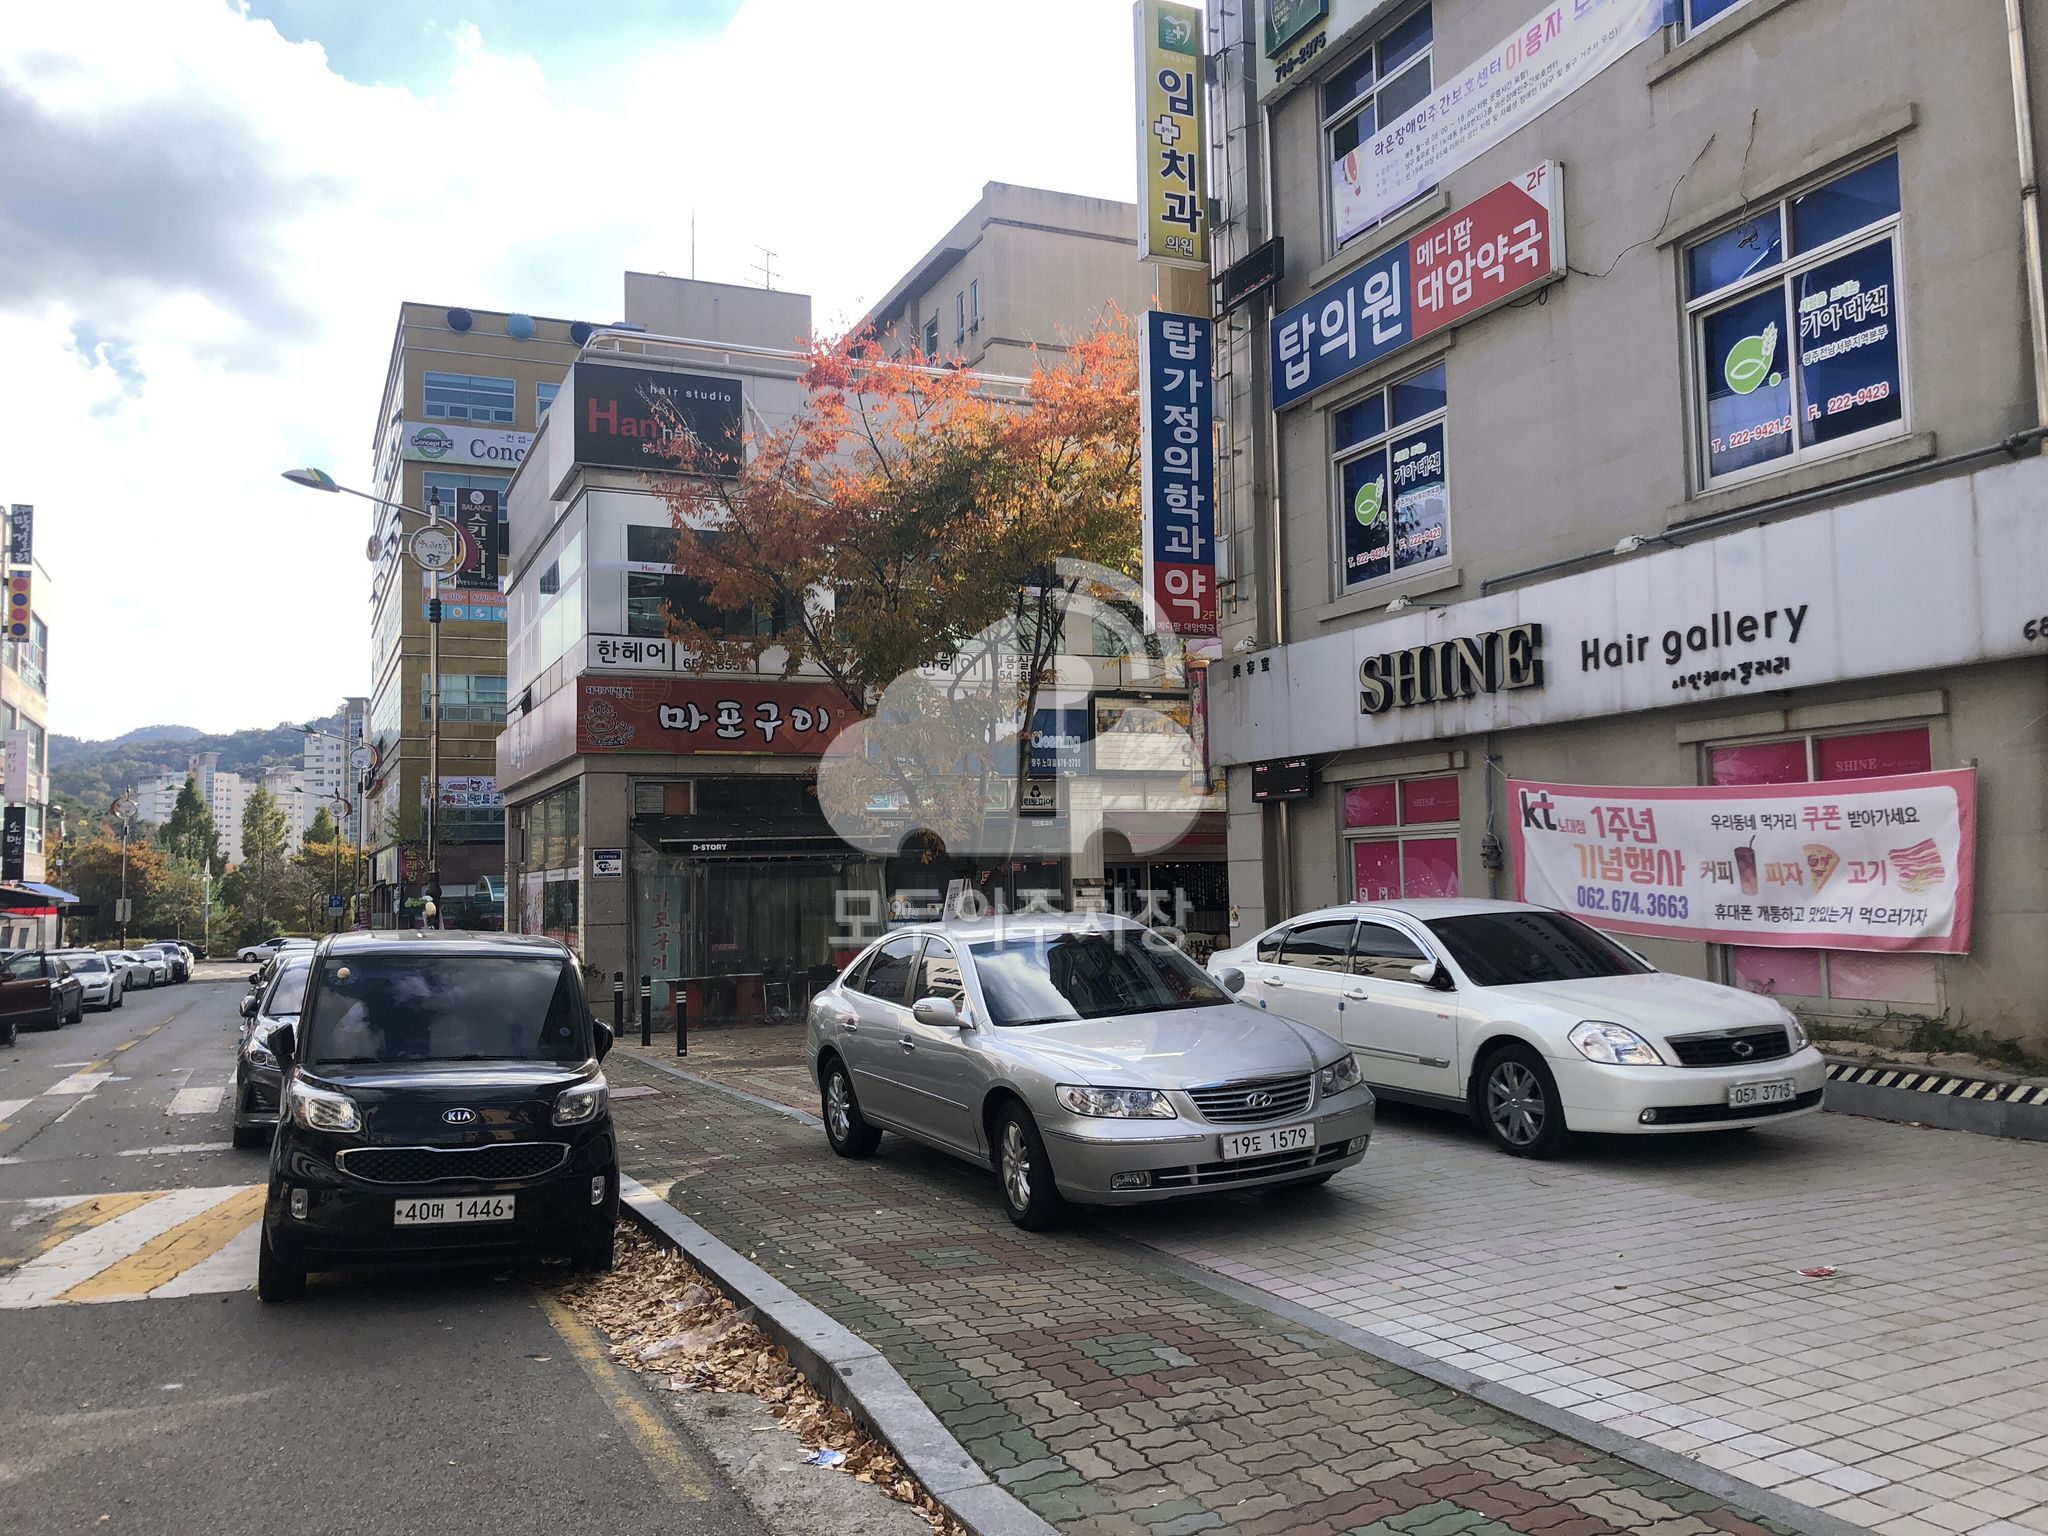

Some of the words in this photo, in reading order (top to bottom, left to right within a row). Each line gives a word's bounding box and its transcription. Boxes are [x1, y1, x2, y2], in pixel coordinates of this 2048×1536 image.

[1505, 7, 1563, 71] 이용자
[1158, 69, 1194, 117] 임
[1526, 168, 1547, 193] 2F
[1166, 236, 1193, 256] 의원
[1416, 217, 1473, 267] 메디팜
[1417, 218, 1543, 313] 대암약국
[1279, 260, 1402, 391] 탑의원
[650, 384, 679, 397] hair
[686, 389, 731, 403] studio
[1807, 405, 1822, 422] F.
[1827, 381, 1889, 415] 222-9423
[587, 398, 657, 440] Han
[440, 439, 453, 449] PC
[461, 503, 493, 512] BALANCE
[1164, 569, 1206, 620] 약
[1202, 610, 1215, 621] 2F
[1581, 634, 1650, 672] Hair
[1662, 604, 1809, 666] gallery
[597, 640, 666, 665] 한헤어
[1359, 623, 1544, 714] SHINE
[657, 699, 830, 743] 마포구이
[1031, 730, 1081, 754] Cleaning
[1021, 797, 1055, 807] 린토피아
[1520, 790, 1558, 831] kt
[1590, 806, 1658, 844] 1주년
[1711, 813, 1757, 832] 우리동네
[1761, 813, 1798, 831] 먹거리
[1802, 804, 1842, 832] 쿠폰
[1847, 807, 1921, 829] 받아가세요
[692, 843, 727, 852] D-STORY
[1573, 843, 1686, 887] 기념행사
[1700, 860, 1734, 885] 커피
[1763, 861, 1804, 886] 피자
[1847, 860, 1888, 886] 고기
[1577, 885, 1689, 920] 062.674.3663
[1714, 903, 1753, 922] 휴대폰
[1757, 905, 1805, 923] 개통하고
[1859, 907, 1928, 927] 먹으러가자
[1762, 1083, 1791, 1101] 3713
[447, 1111, 472, 1122] KIA
[1232, 1136, 1262, 1155] 19도
[1269, 1128, 1307, 1149] 1579
[404, 1200, 444, 1220] 40머
[455, 1198, 504, 1219] 1446
